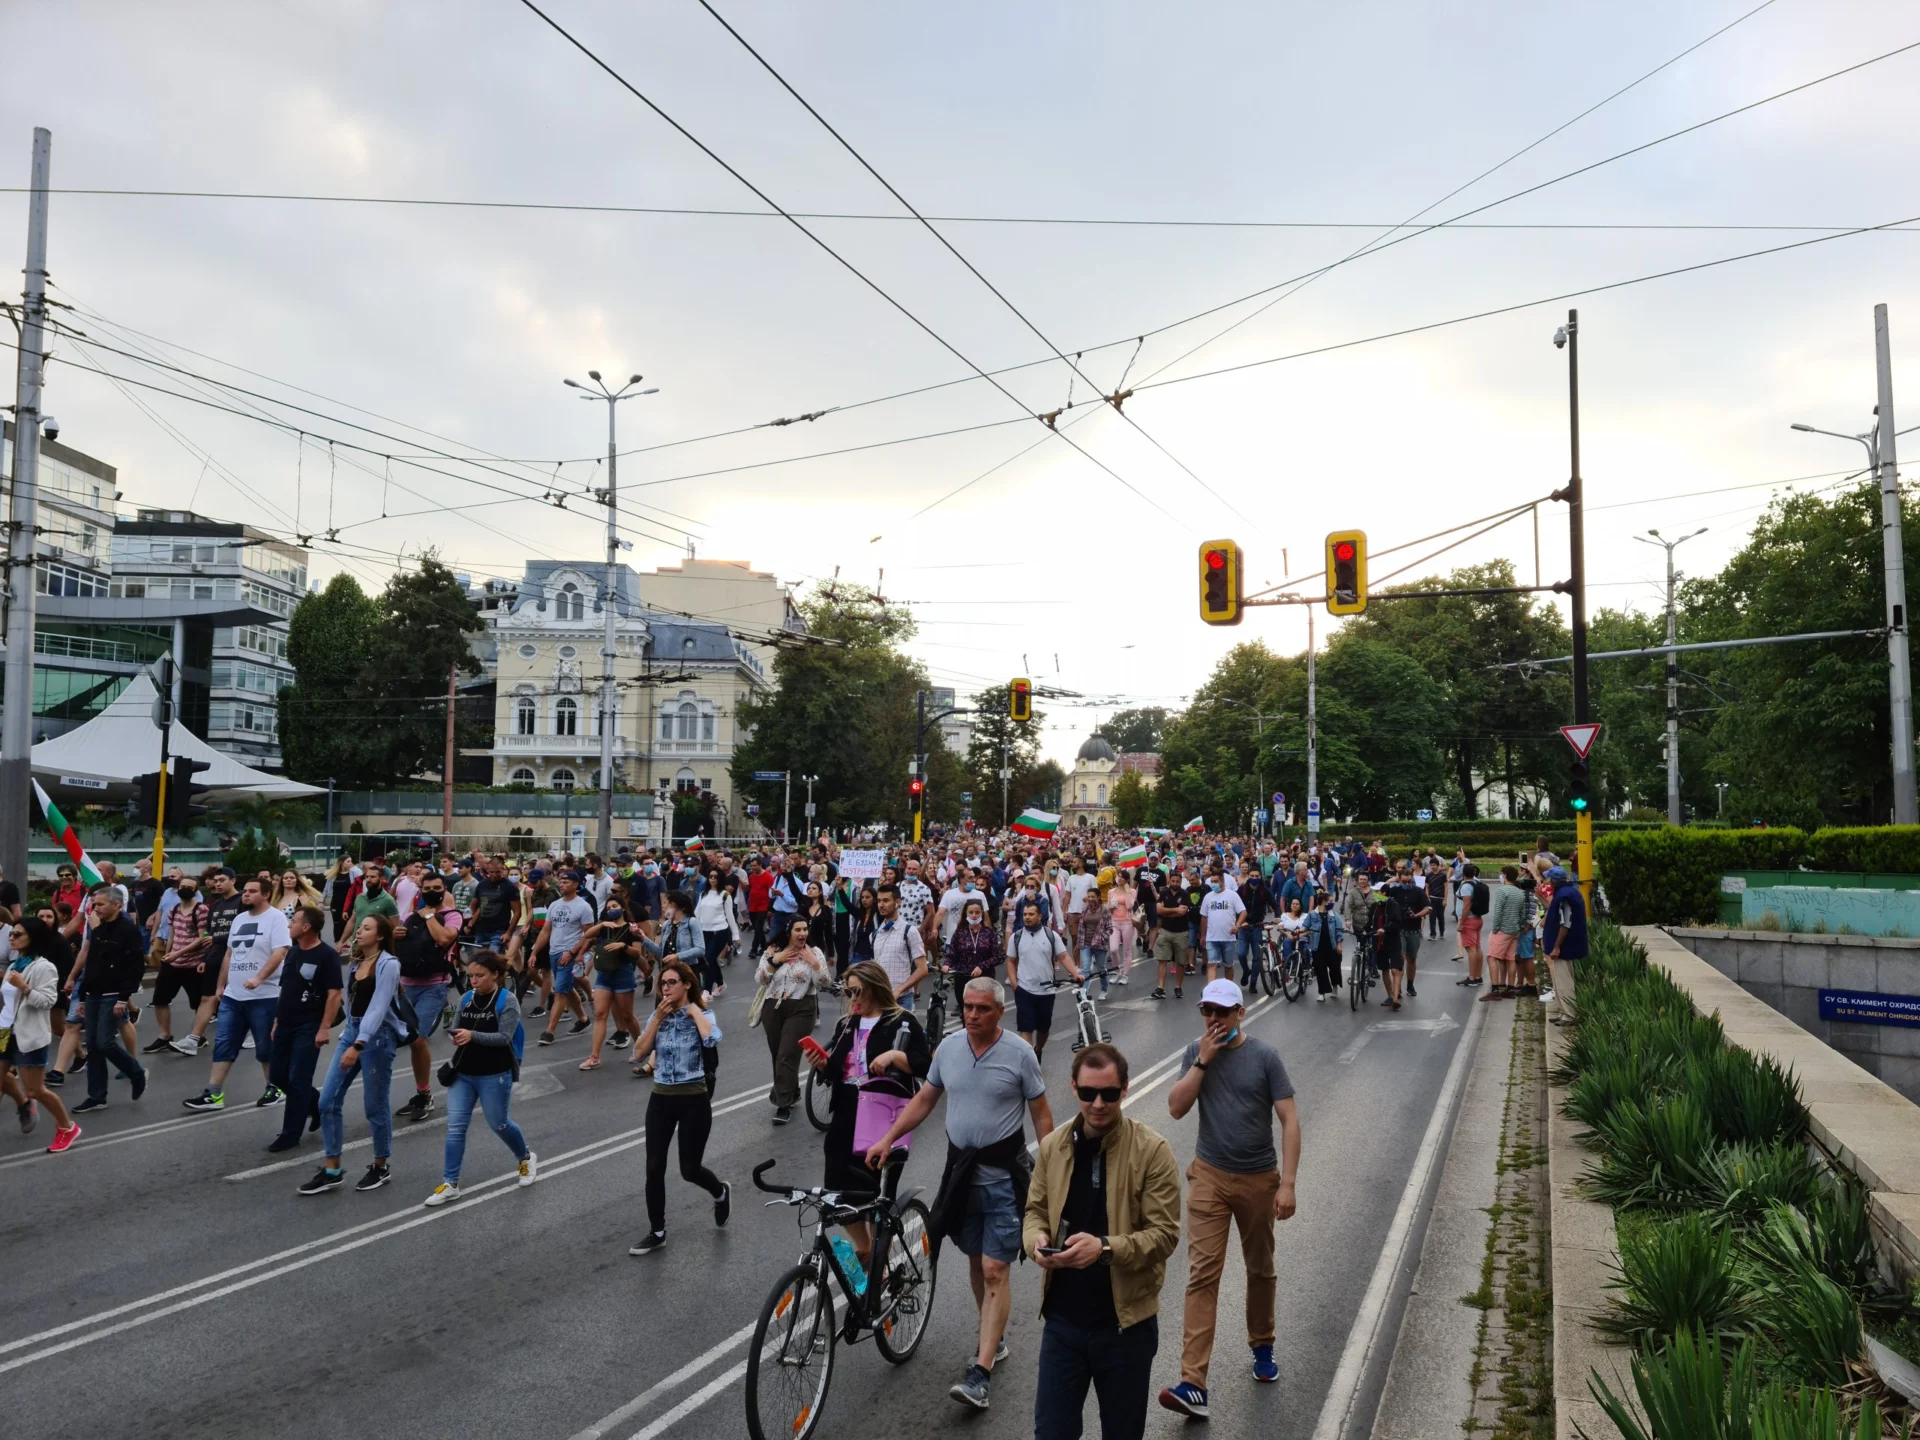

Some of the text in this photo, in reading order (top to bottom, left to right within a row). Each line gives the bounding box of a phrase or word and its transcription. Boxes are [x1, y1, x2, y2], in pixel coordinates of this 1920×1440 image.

[85, 780, 100, 788] CLUB
[846, 851, 878, 859] БЪЛГАРИЯ
[1851, 998, 1887, 1008] КЛИМЕНТ
[1858, 1010, 1887, 1018] KLIMENT
